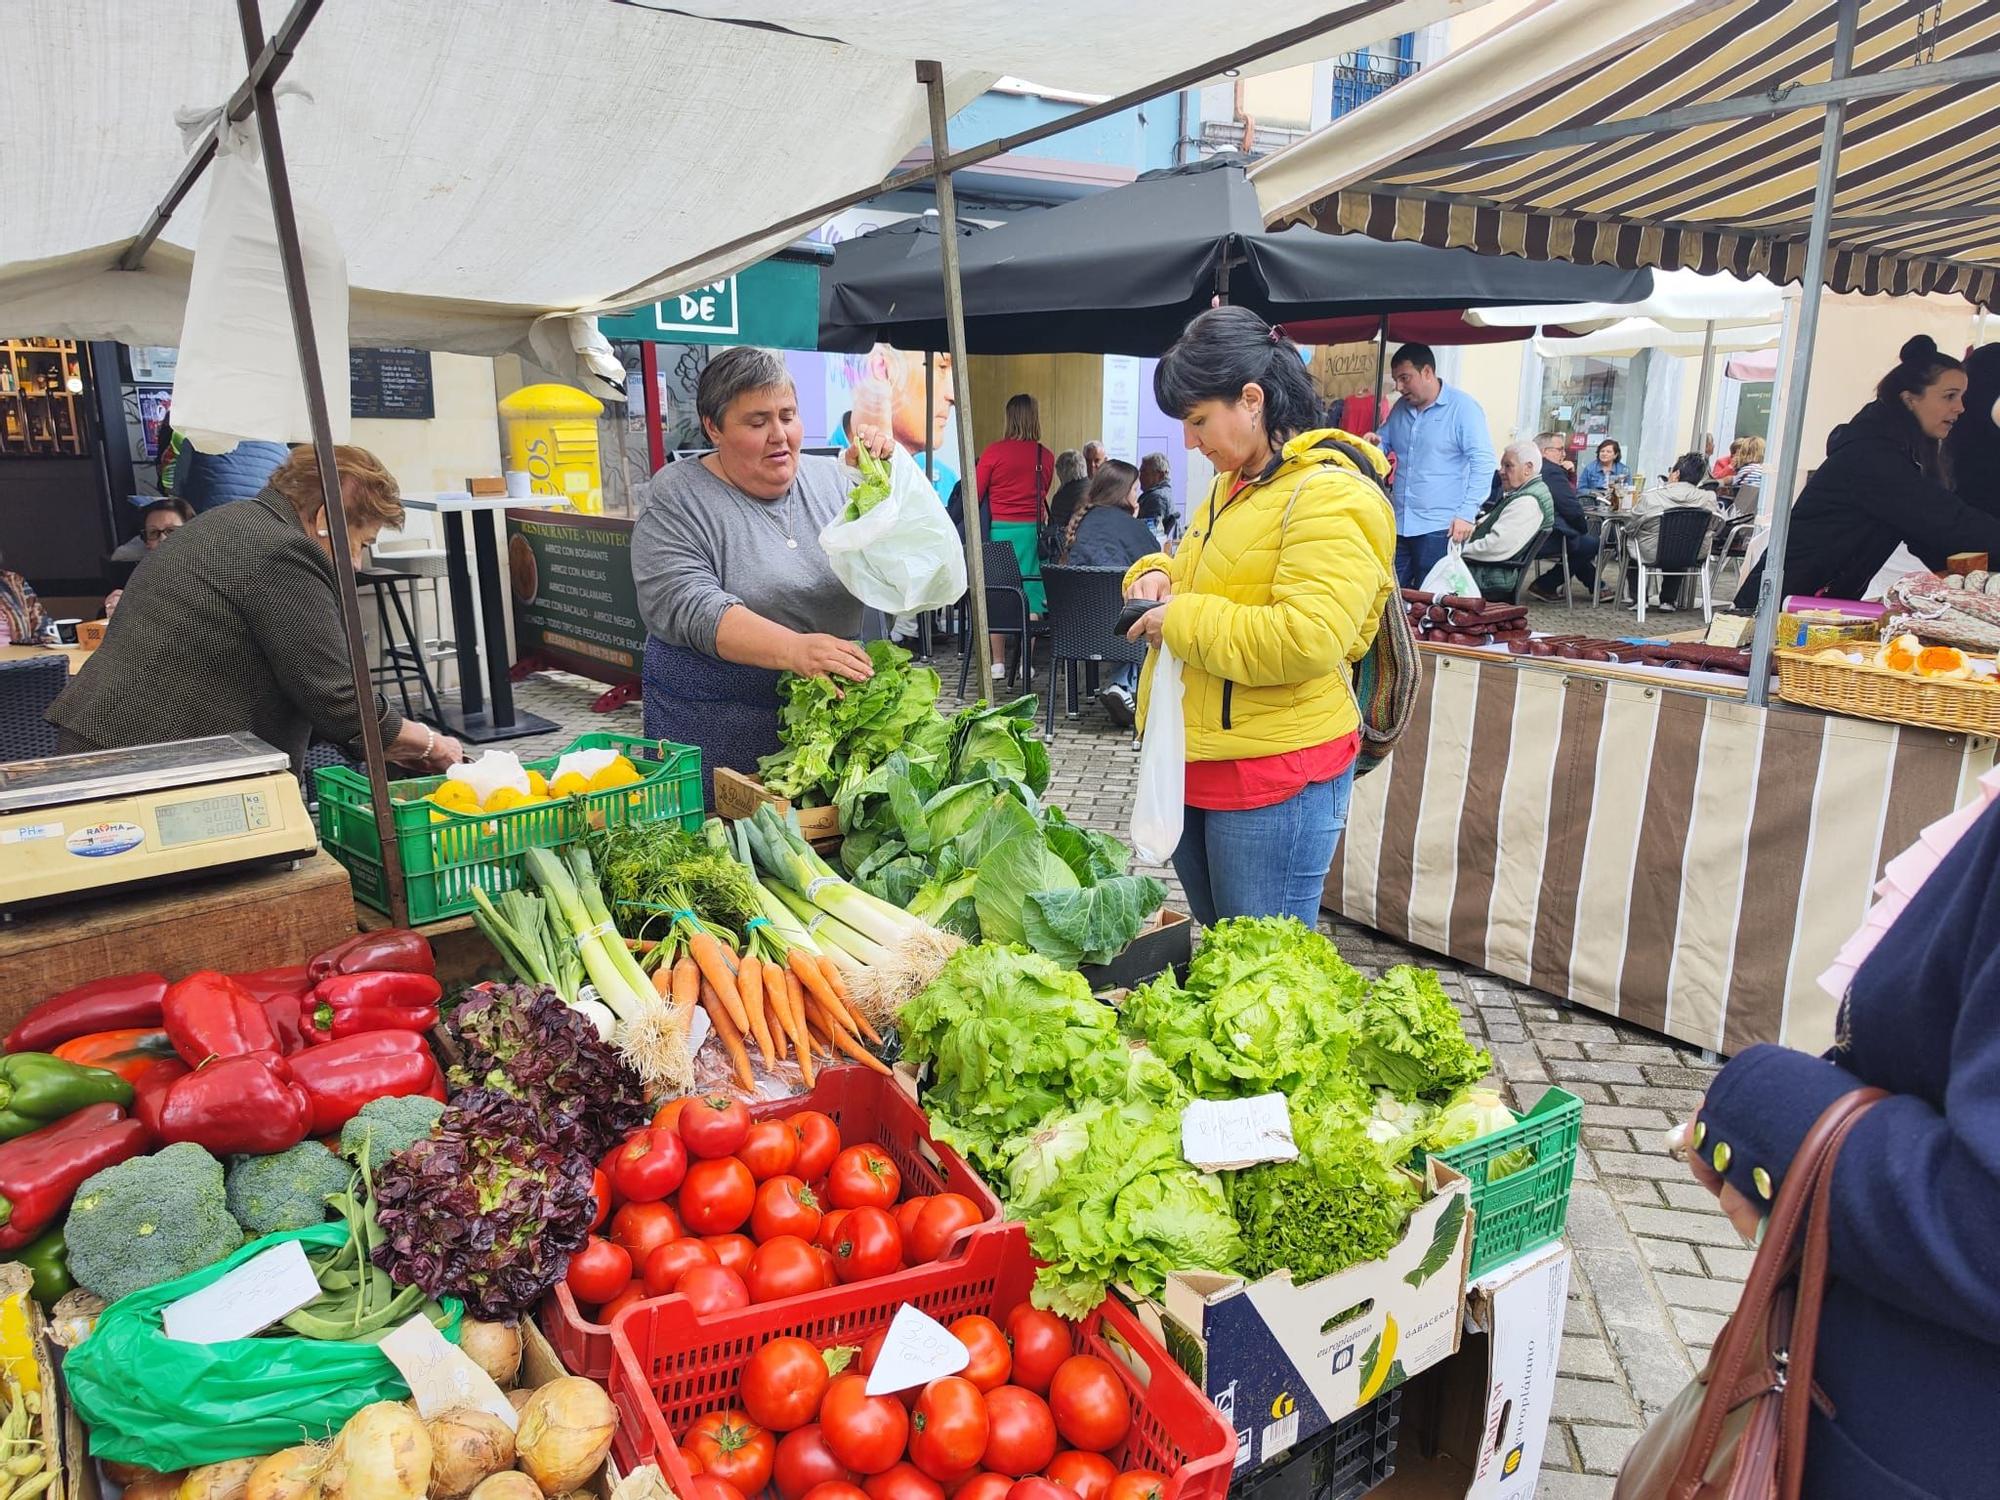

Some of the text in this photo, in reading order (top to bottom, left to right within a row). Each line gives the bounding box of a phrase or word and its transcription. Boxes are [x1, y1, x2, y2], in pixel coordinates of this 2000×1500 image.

[679, 294, 715, 321] DE
[562, 546, 575, 557] CON
[568, 566, 580, 577] CON
[566, 584, 579, 595] CON
[1404, 1304, 1456, 1339] GABACERAS
[1477, 1381, 1504, 1480] PREMIUM
